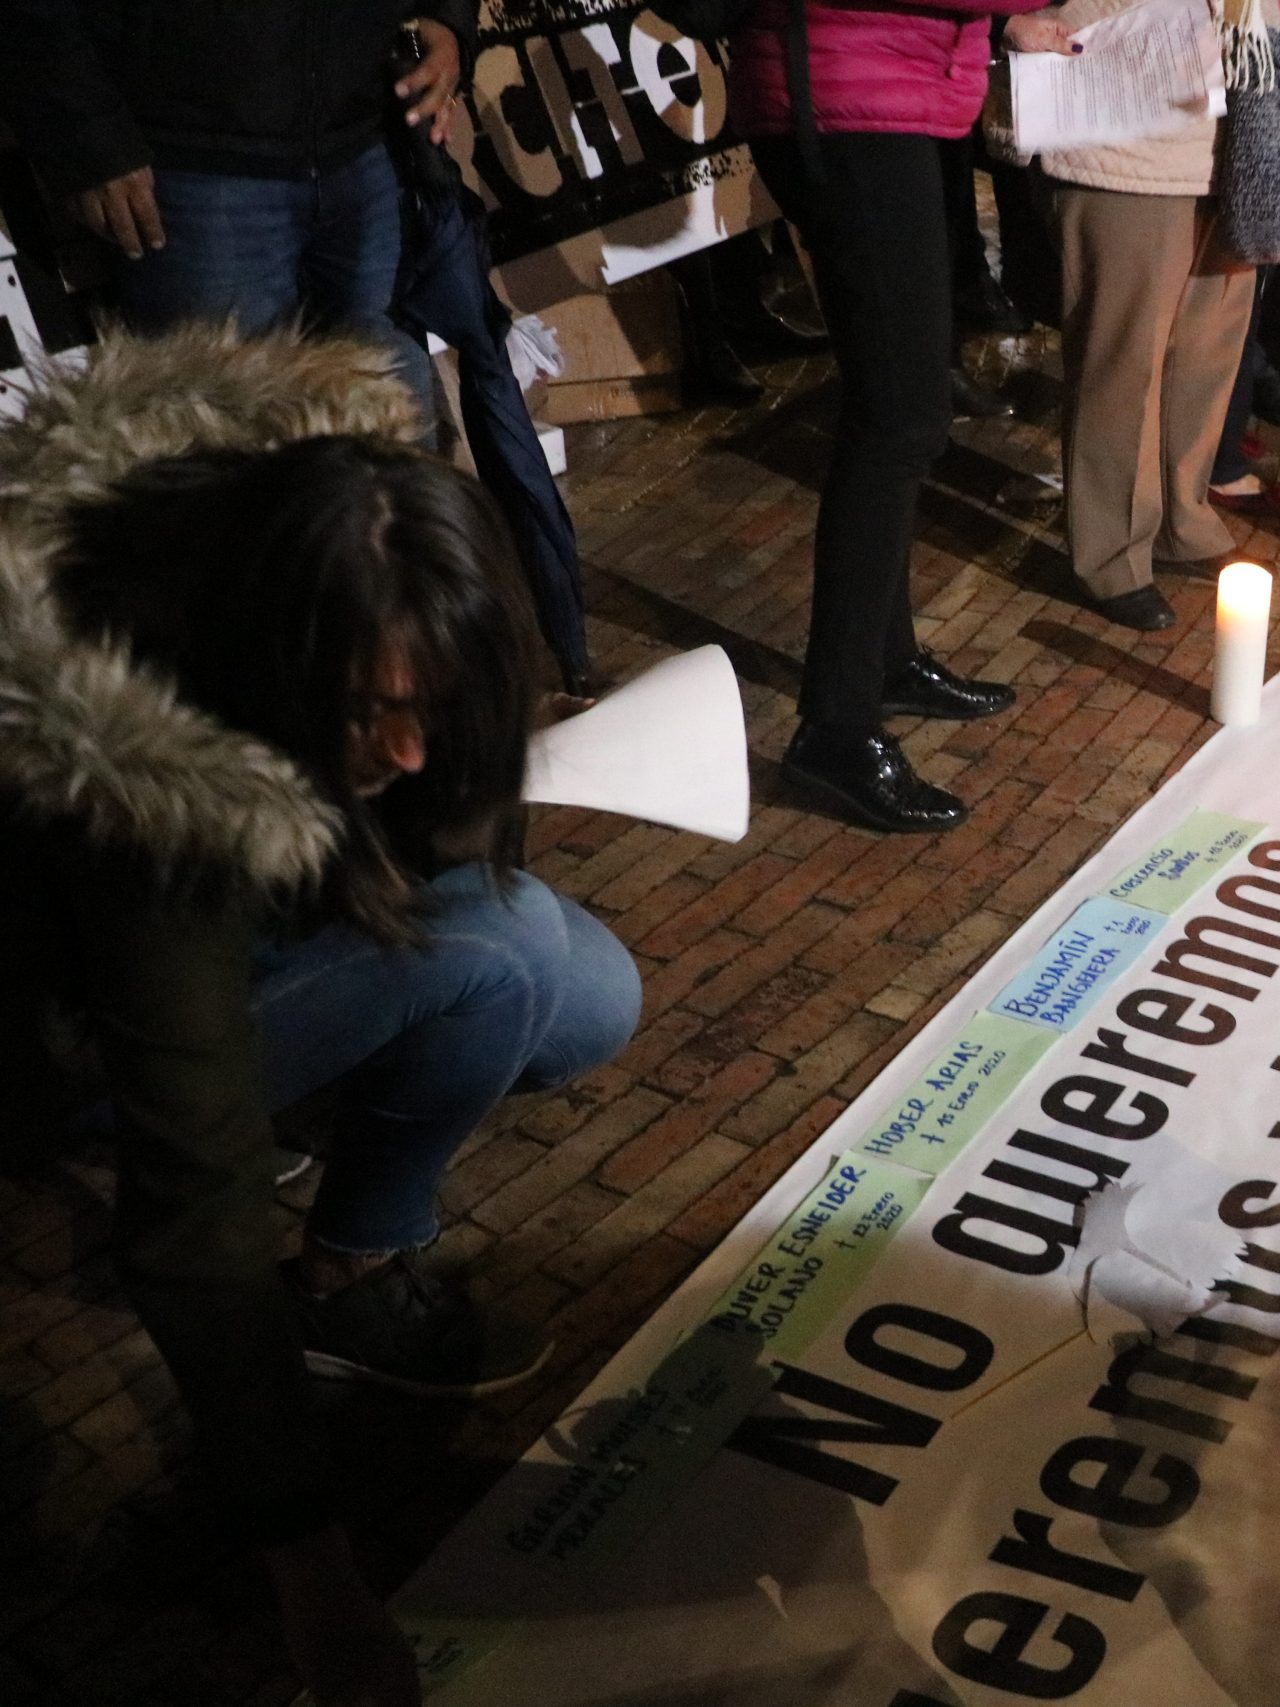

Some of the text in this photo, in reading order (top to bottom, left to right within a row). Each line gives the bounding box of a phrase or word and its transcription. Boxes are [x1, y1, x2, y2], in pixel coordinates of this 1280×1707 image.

[1003, 928, 1094, 1019] BENJAMÍN
[926, 1039, 983, 1091] ARIAS
[725, 1304, 994, 1506] No
